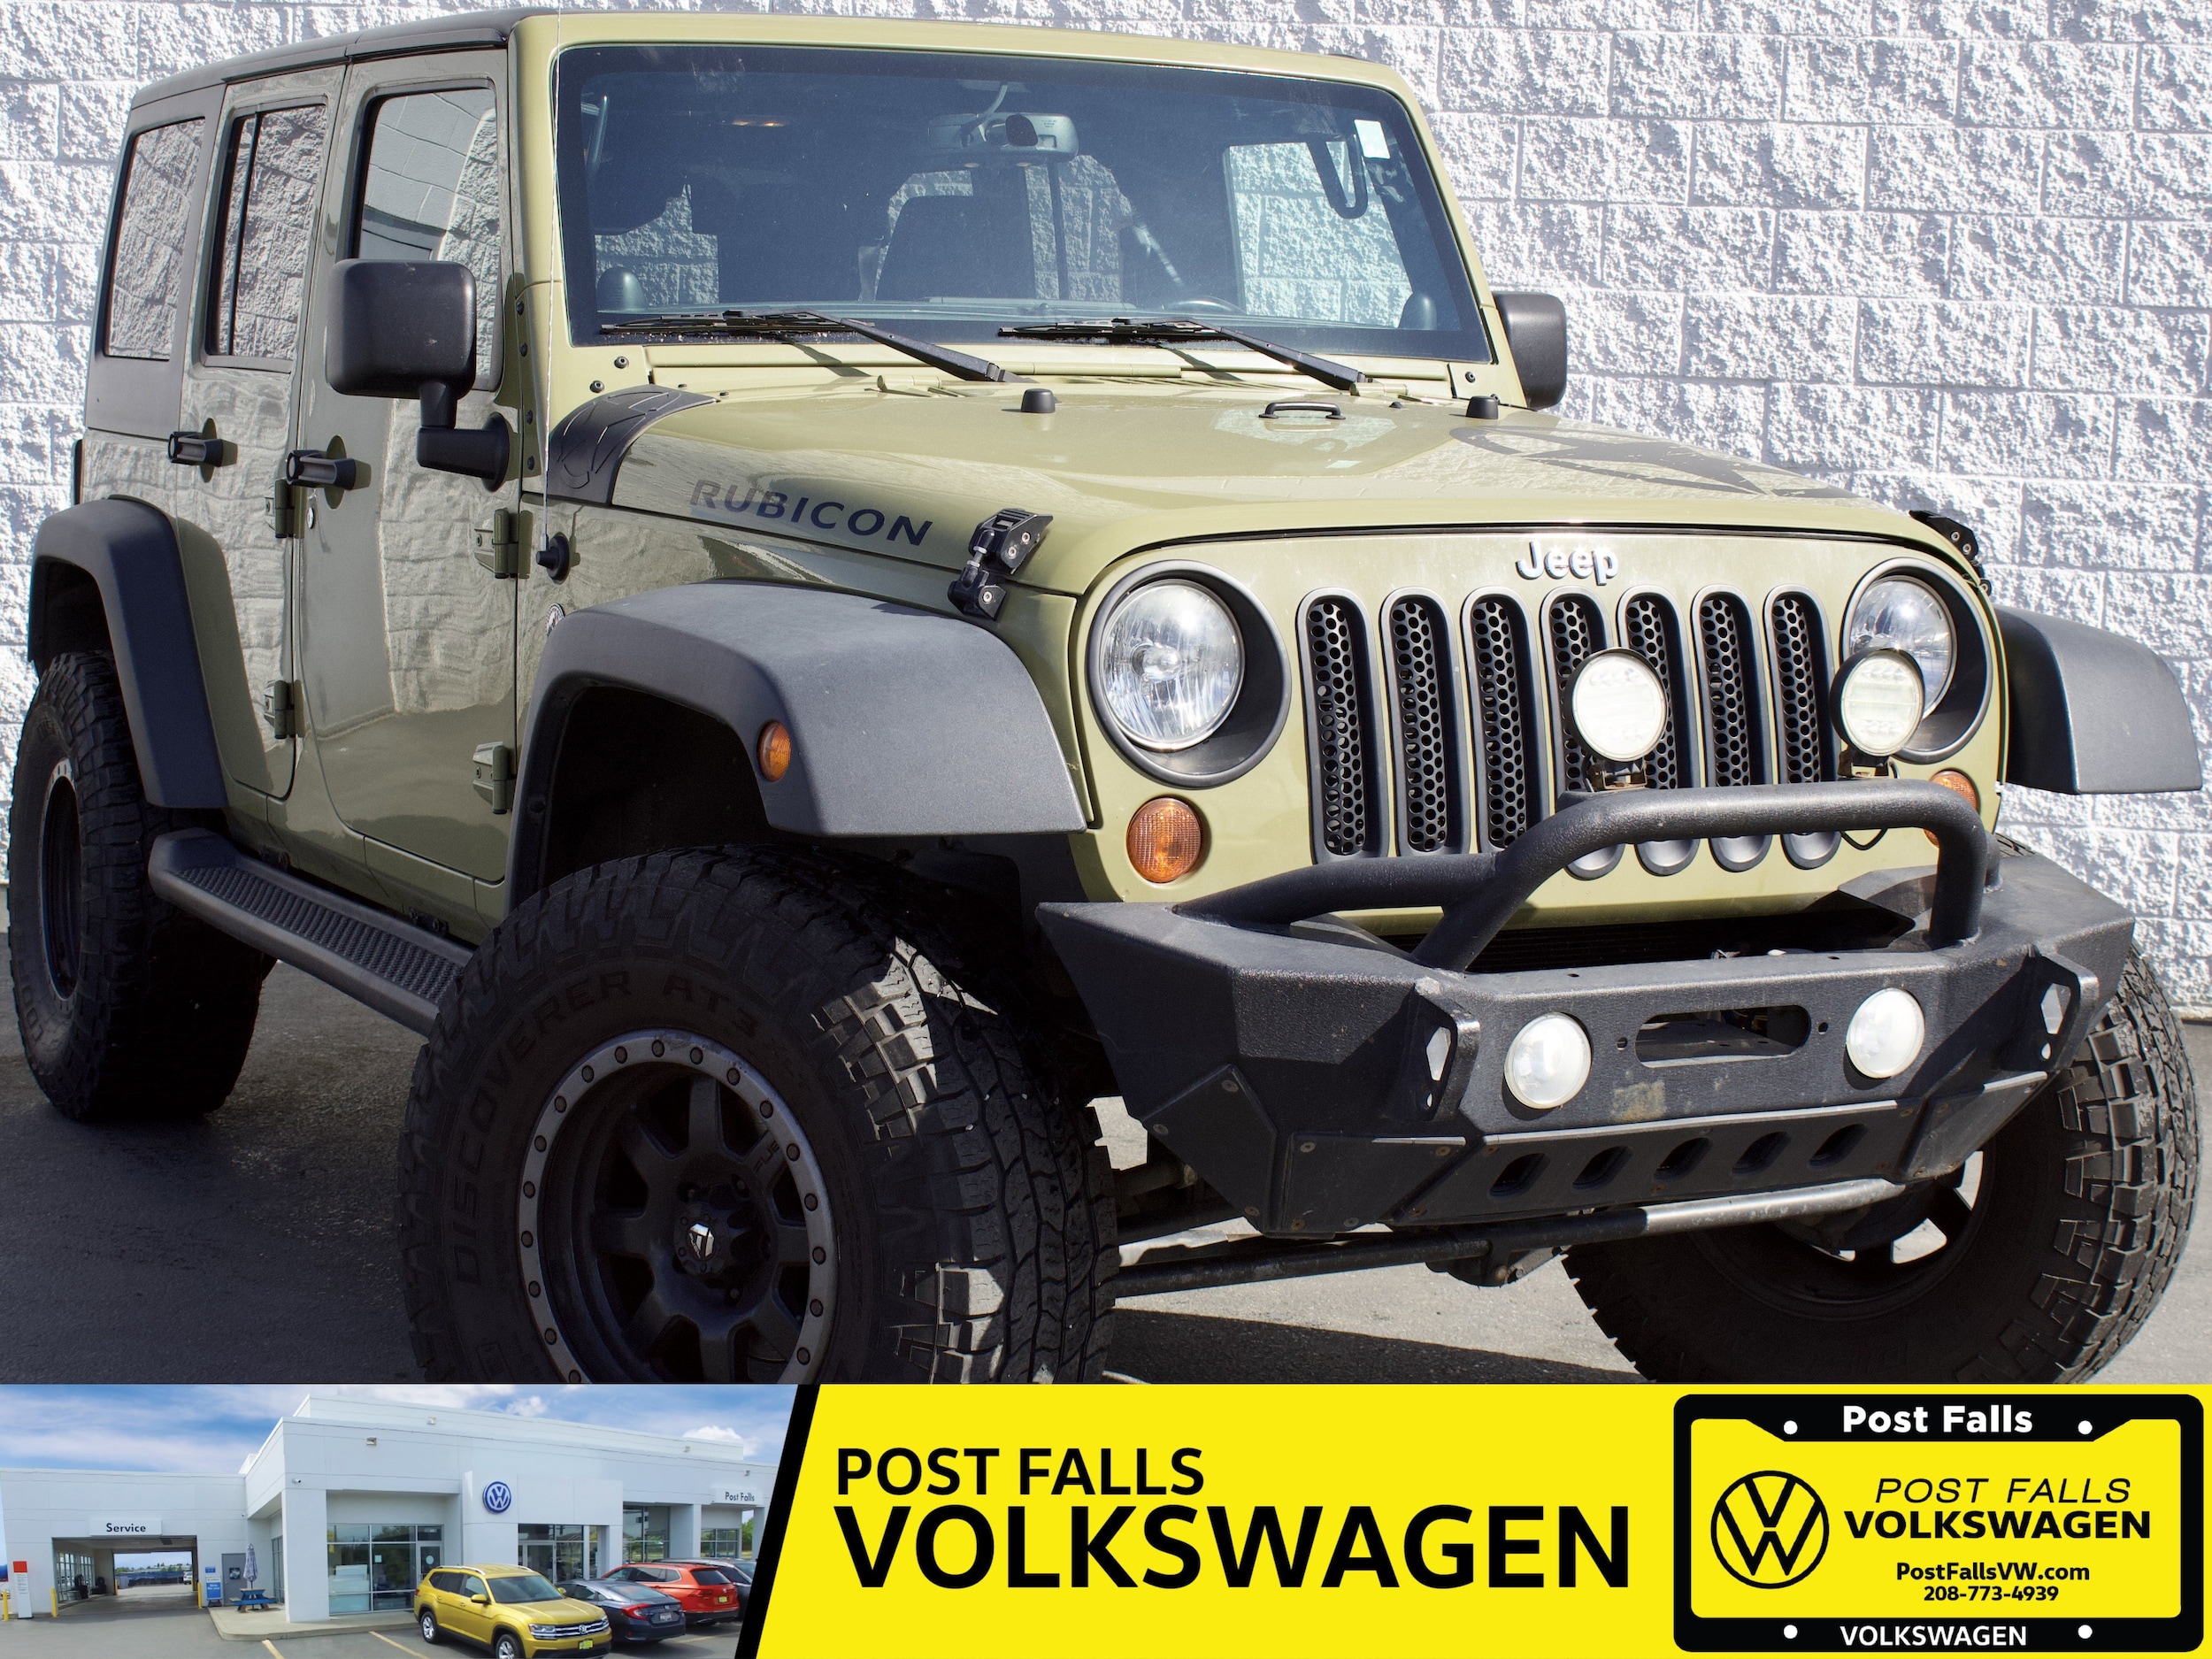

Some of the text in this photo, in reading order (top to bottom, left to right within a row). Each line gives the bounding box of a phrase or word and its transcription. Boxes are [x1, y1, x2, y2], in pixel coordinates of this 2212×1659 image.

[690, 479, 934, 546] RUBICON
[1516, 541, 1618, 586] Jeep
[451, 969, 633, 1286] DISCOVERER
[662, 972, 761, 1039] AT3
[753, 1140, 780, 1172] FUE
[725, 1491, 756, 1502] Post Falls
[105, 1522, 147, 1532] Service
